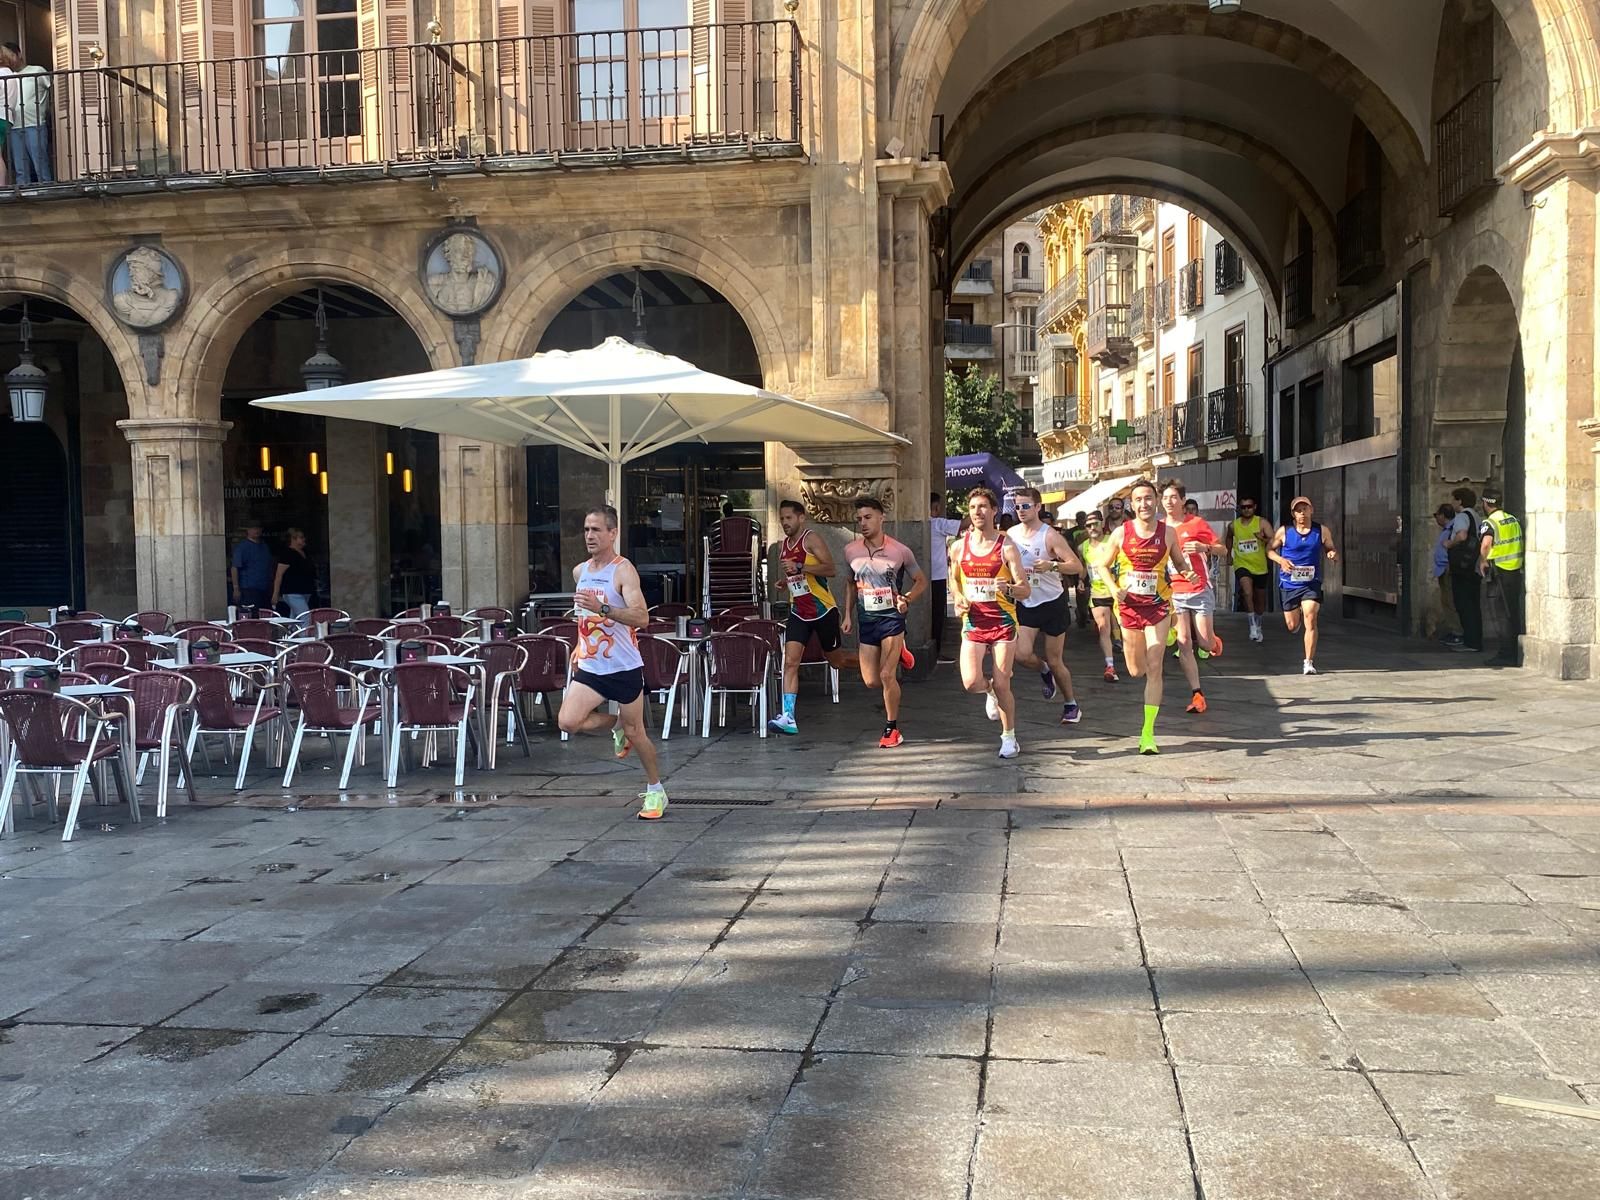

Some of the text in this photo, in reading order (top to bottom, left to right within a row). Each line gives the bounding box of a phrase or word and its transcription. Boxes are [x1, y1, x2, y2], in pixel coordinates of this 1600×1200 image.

[1136, 580, 1147, 588] 16
[974, 586, 986, 594] 14
[872, 596, 883, 605] 28
